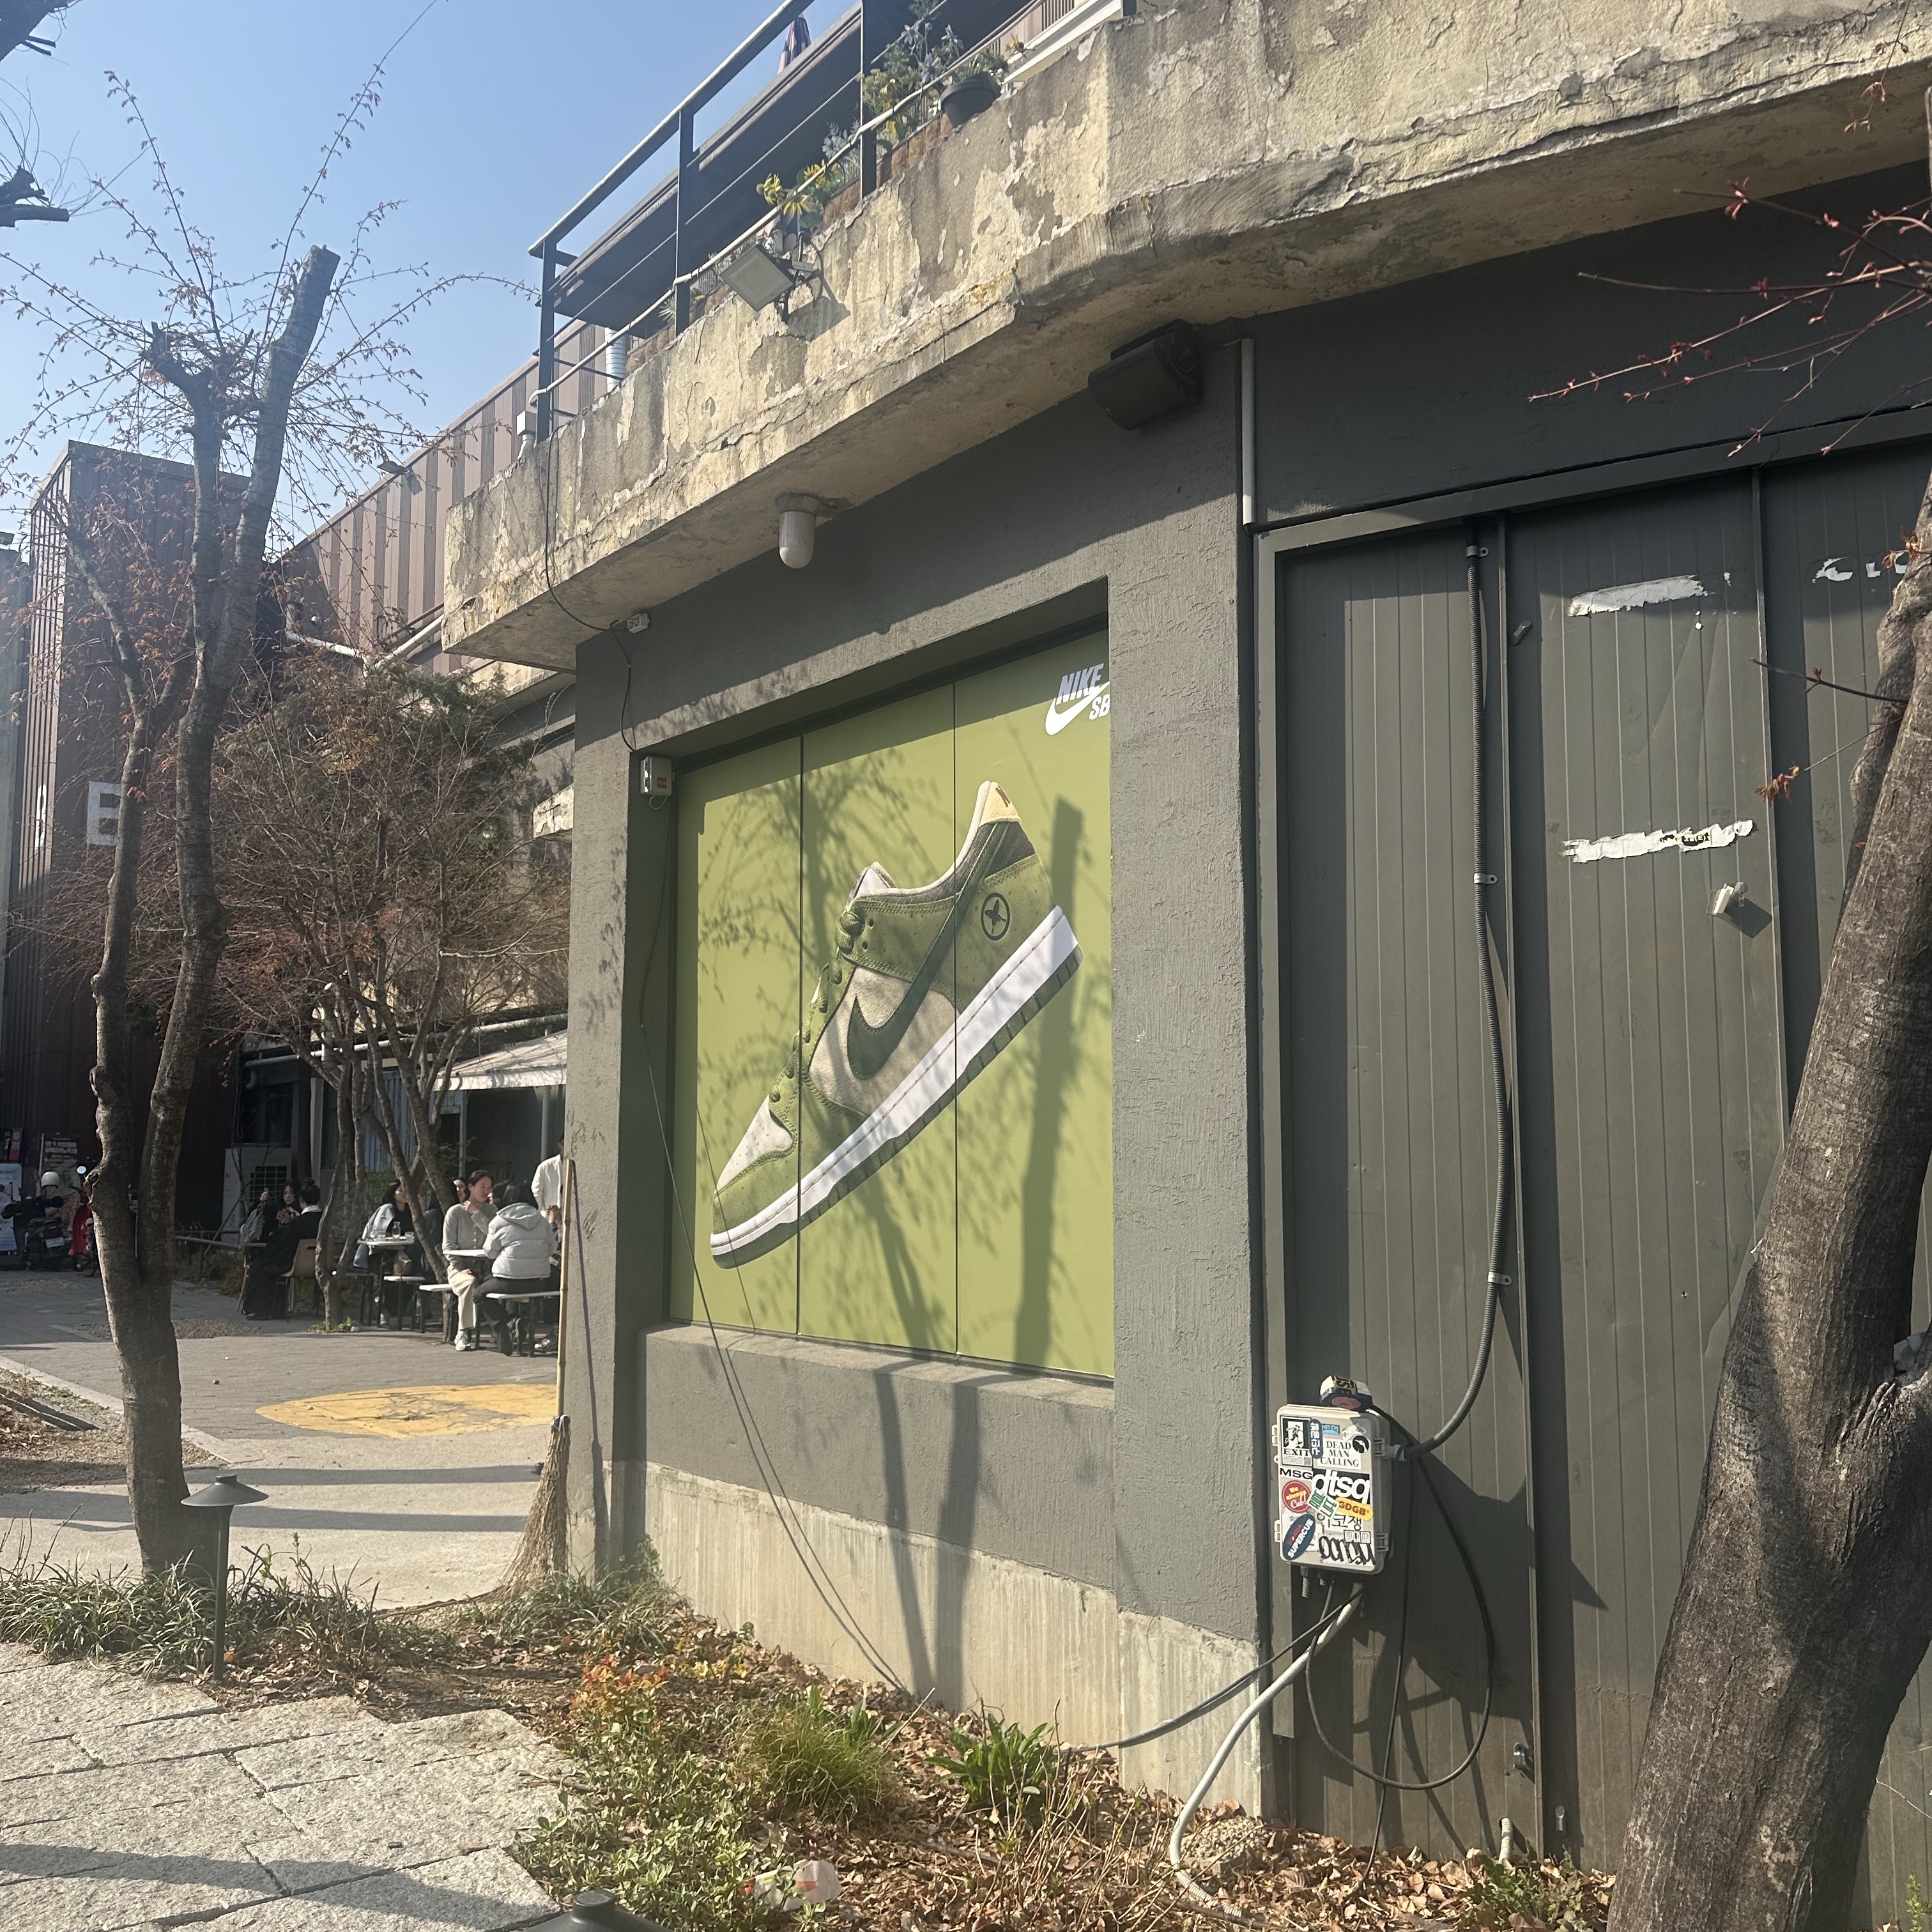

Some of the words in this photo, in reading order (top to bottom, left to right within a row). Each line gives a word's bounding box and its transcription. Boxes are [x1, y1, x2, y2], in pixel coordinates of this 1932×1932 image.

[1056, 663, 1104, 705] NIKE
[1089, 694, 1110, 720] SB
[1326, 1441, 1351, 1450] DEAD
[1284, 1448, 1310, 1457] EXIT
[1329, 1449, 1350, 1458] MAN
[1320, 1457, 1360, 1468] CALLING
[1280, 1468, 1313, 1480] MSG
[1312, 1469, 1370, 1505] dtsq
[1287, 1519, 1314, 1558] SUPERCUB
